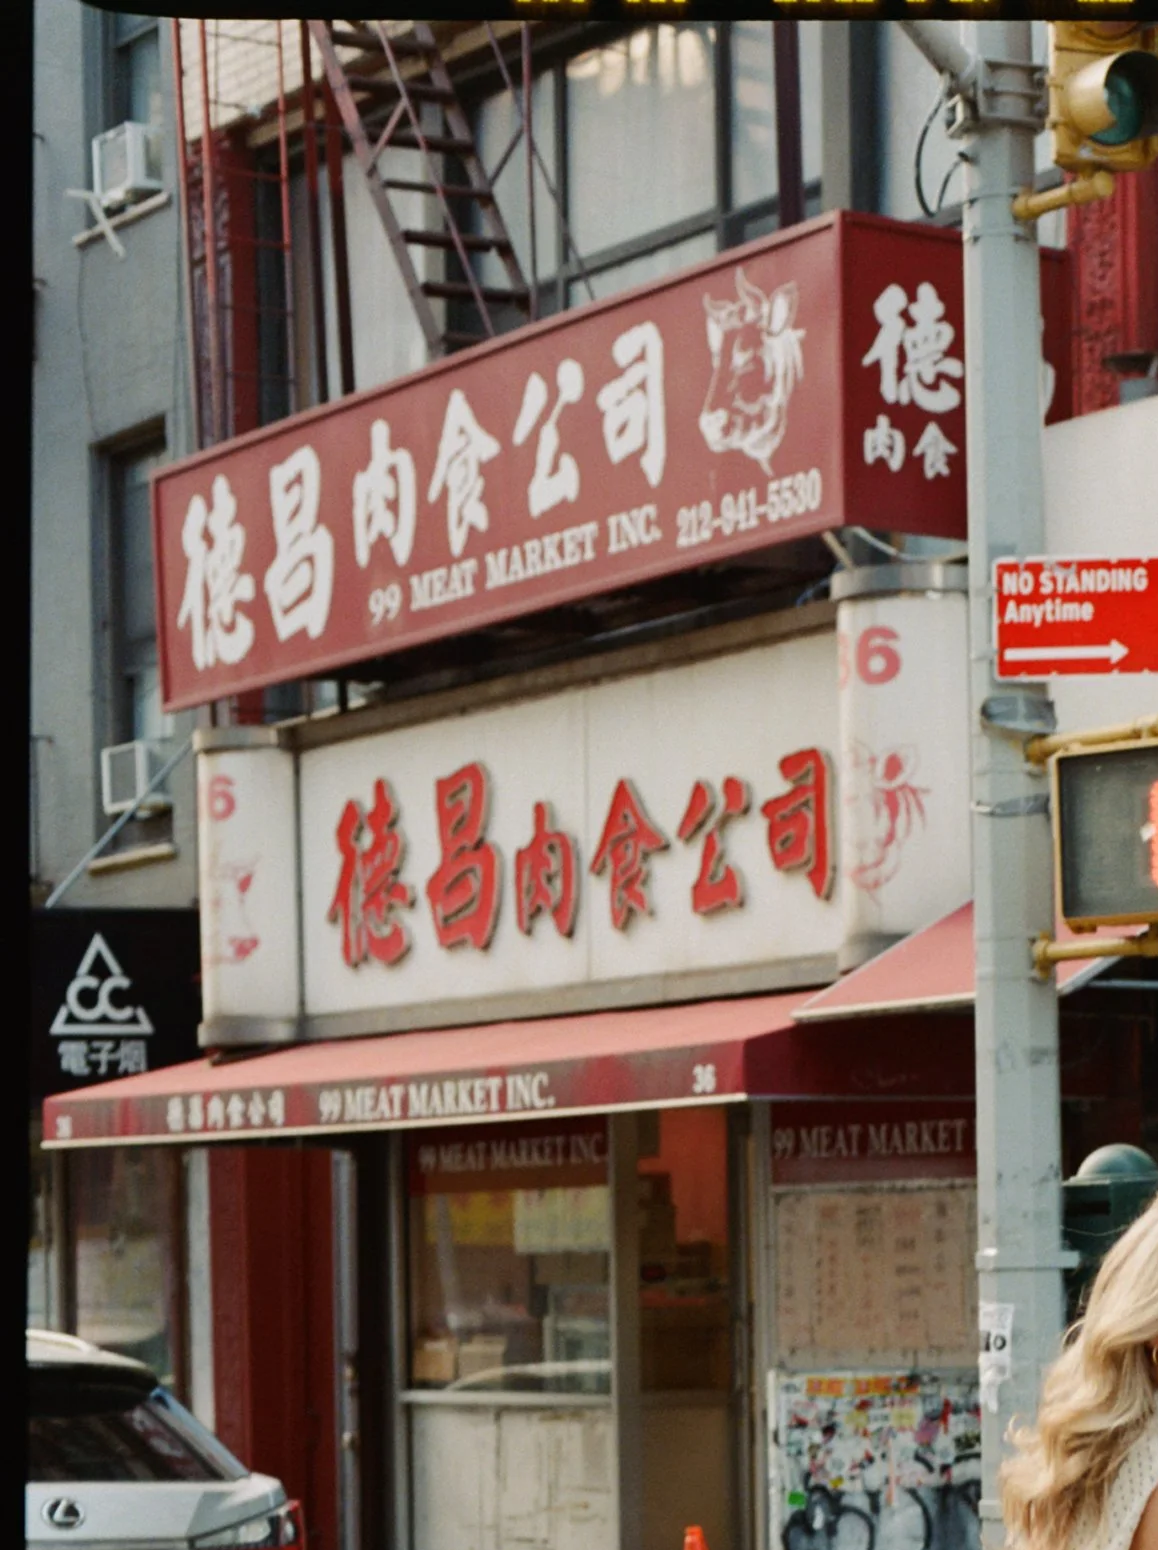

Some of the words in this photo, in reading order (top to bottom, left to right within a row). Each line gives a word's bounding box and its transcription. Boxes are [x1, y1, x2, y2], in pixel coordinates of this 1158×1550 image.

[861, 281, 965, 413] 德
[863, 413, 959, 481] 肉食
[178, 319, 667, 672] 德昌肉食公司
[369, 582, 400, 625] 99
[410, 558, 477, 611] MEAT
[485, 521, 599, 590] MARKET
[607, 503, 662, 554] INC.
[1002, 571, 1032, 595] NO
[1039, 567, 1148, 595] STANDING
[1004, 599, 1094, 627] Anytime
[328, 747, 836, 967] 德昌肉食公司
[319, 1090, 341, 1123] 99
[344, 1083, 405, 1121] MEAT
[408, 1076, 504, 1118] MARKET
[506, 1071, 556, 1110] INC.
[439, 1140, 486, 1173] MEAT
[490, 1136, 565, 1170] MARKET
[773, 1127, 796, 1160] 99
[800, 1124, 862, 1158] MEAT
[868, 1118, 967, 1155] MARKET
